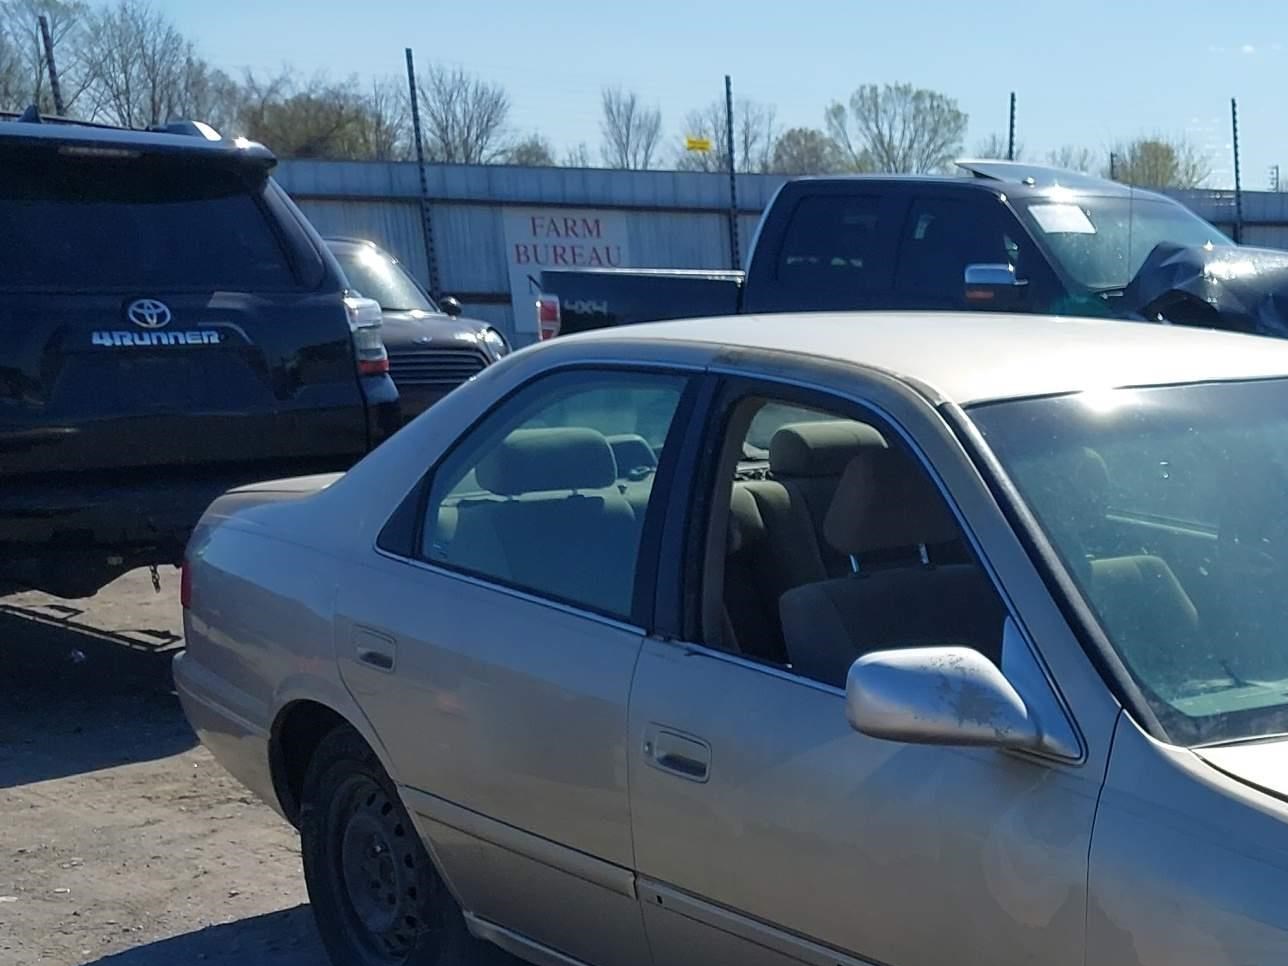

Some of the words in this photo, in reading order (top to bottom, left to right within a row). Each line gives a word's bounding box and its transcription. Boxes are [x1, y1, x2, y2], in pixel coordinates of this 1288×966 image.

[530, 216, 602, 239] FARM
[515, 243, 621, 267] BUREAU
[92, 331, 220, 346] 4RUNNER
